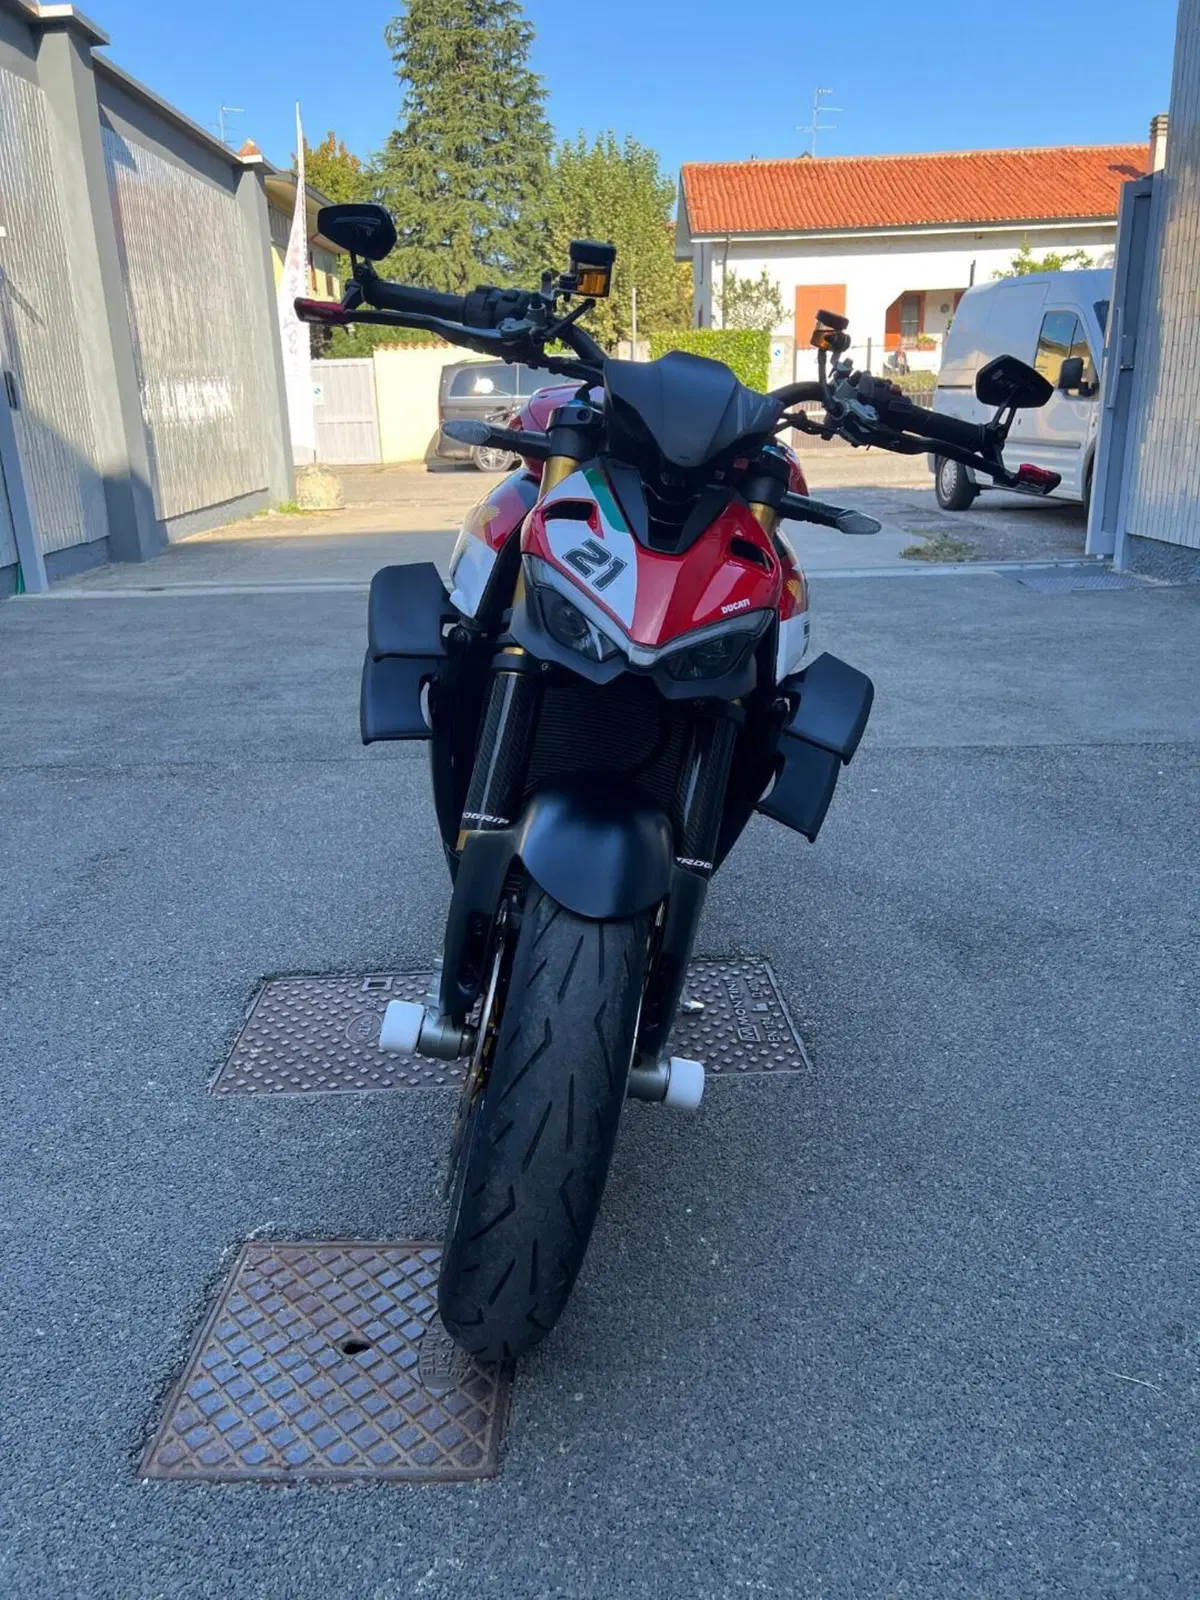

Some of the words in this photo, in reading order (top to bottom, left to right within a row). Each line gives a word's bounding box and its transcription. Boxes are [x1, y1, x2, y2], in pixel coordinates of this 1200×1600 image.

[561, 539, 628, 592] 21
[721, 598, 750, 614] DUCATI
[726, 981, 751, 1027] MONTINI
[766, 1031, 780, 1042] EN
